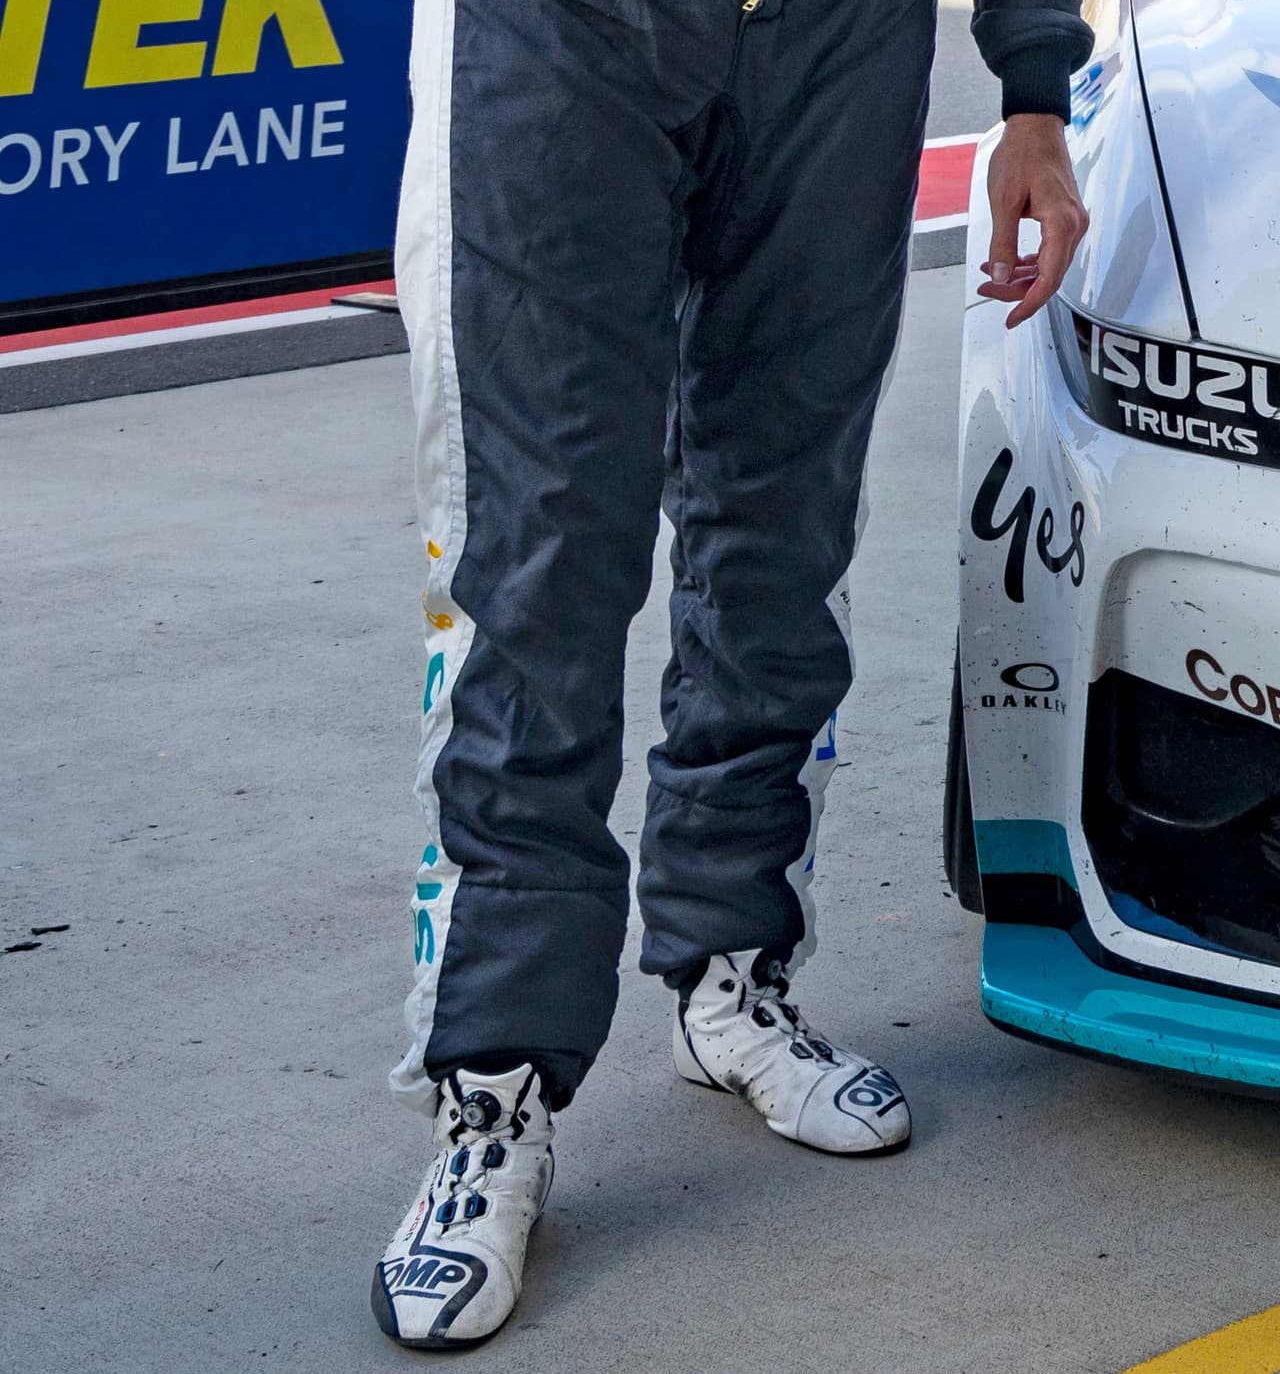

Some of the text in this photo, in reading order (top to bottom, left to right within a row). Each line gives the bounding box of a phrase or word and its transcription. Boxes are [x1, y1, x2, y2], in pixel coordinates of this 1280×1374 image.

[166, 99, 348, 175] LANE
[1117, 399, 1260, 456] TRUCKS
[980, 692, 1069, 717] OAKLEY
